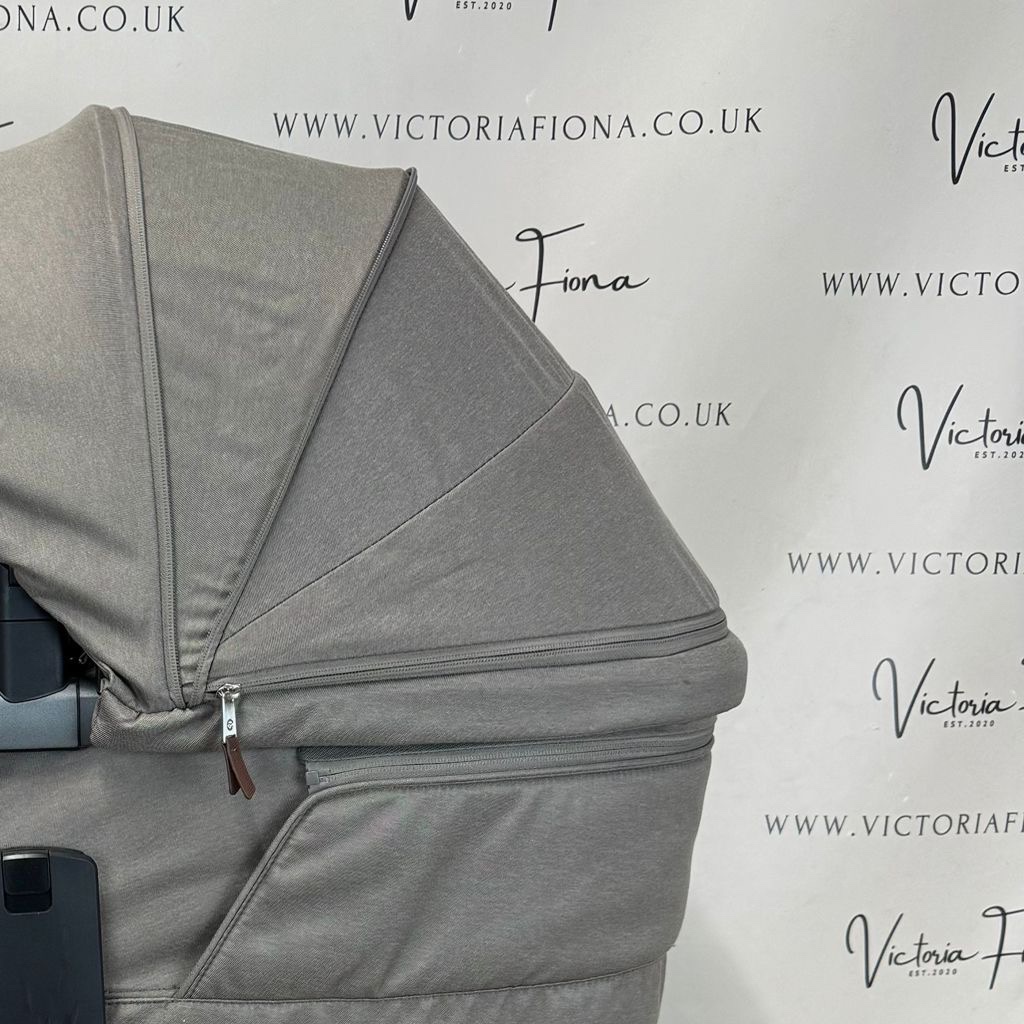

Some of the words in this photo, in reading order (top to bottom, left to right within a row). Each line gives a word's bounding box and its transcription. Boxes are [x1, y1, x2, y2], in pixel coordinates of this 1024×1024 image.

[455, 0, 512, 10] EST.2020
[273, 107, 763, 142] WWW.VICTORIAFIONA.CO.UK
[514, 223, 650, 322] Fiona
[872, 657, 1017, 739] Victoria
[943, 720, 996, 729] EST.2020
[845, 913, 979, 989] Victoria
[908, 968, 958, 977] EST.2020
